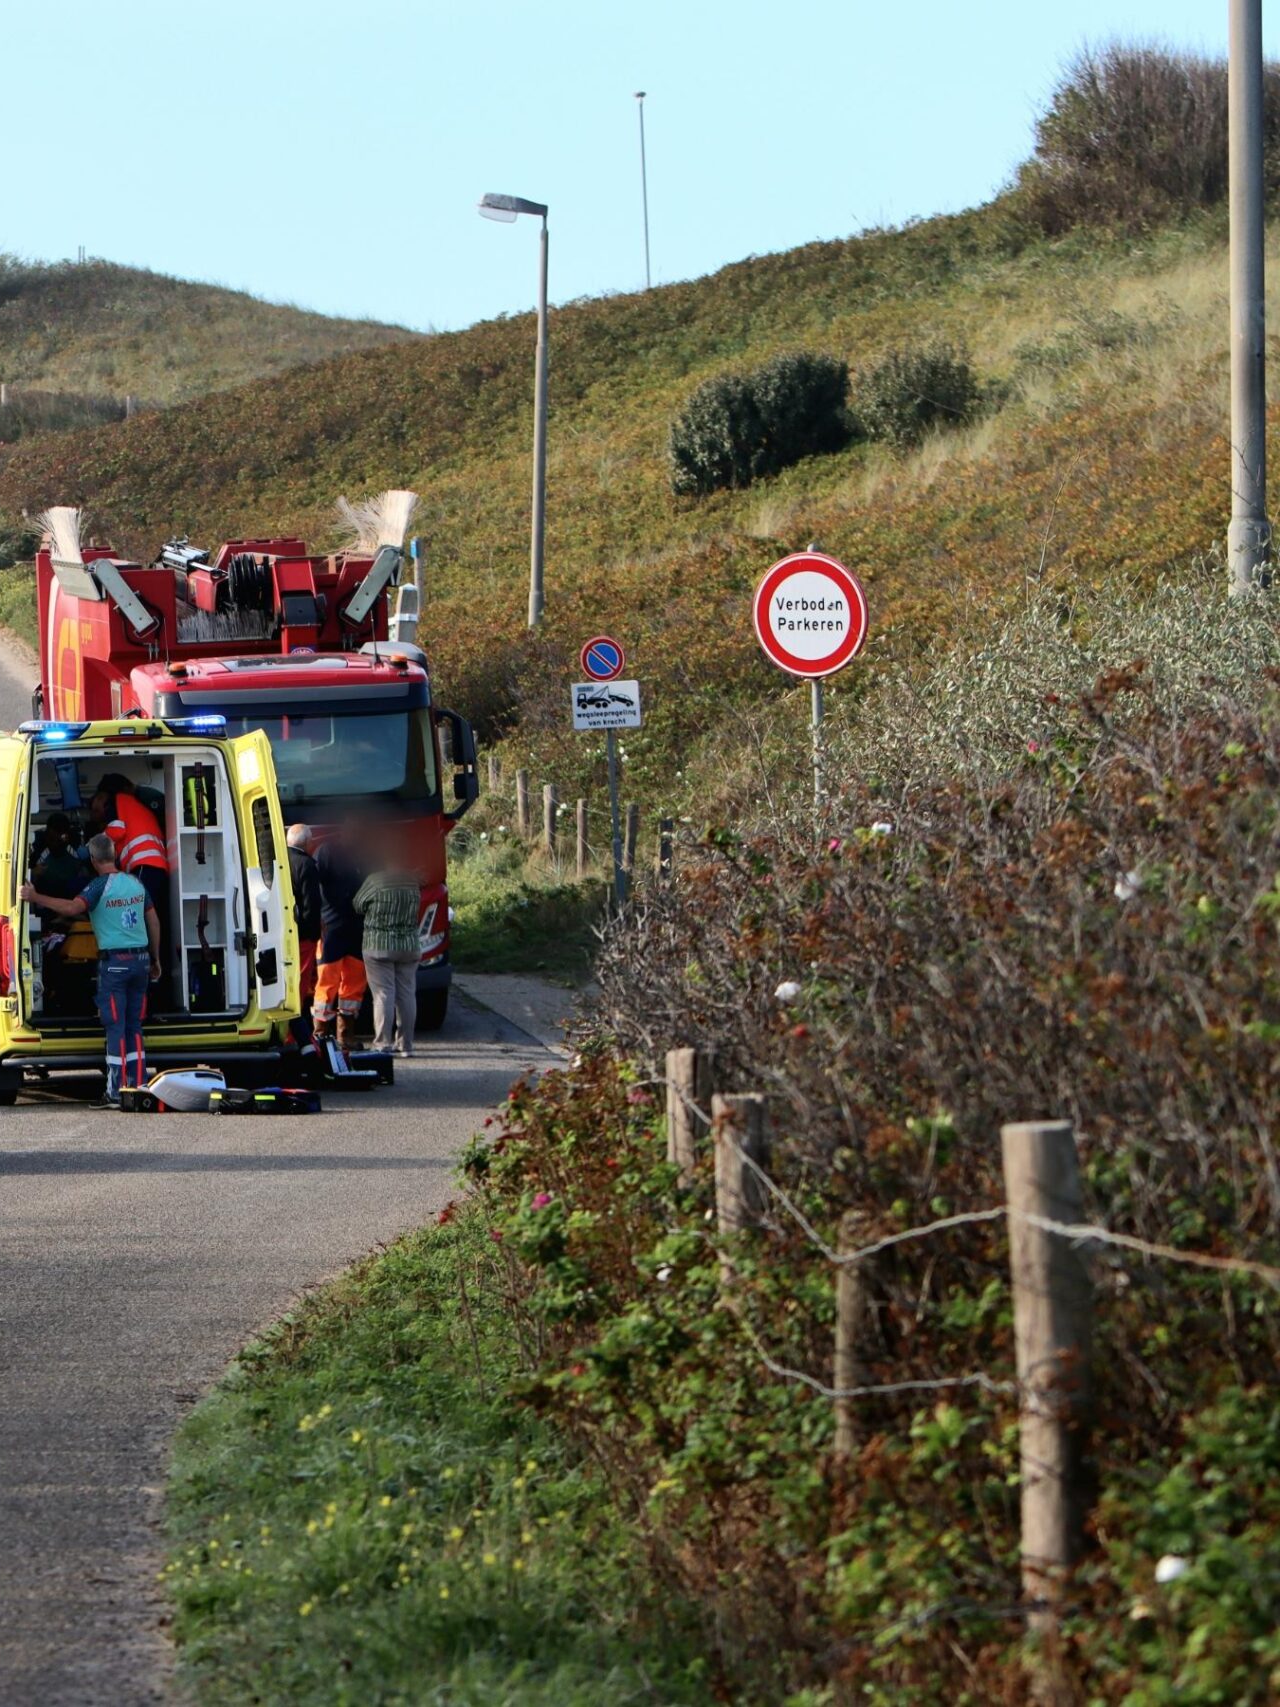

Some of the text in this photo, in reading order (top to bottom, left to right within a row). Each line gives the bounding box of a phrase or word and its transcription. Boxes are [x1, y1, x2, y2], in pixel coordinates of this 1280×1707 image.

[775, 596, 843, 611] Verboden
[777, 616, 843, 631] Parkeren
[576, 708, 637, 719] wegsleepregeling
[603, 717, 626, 726] kracht
